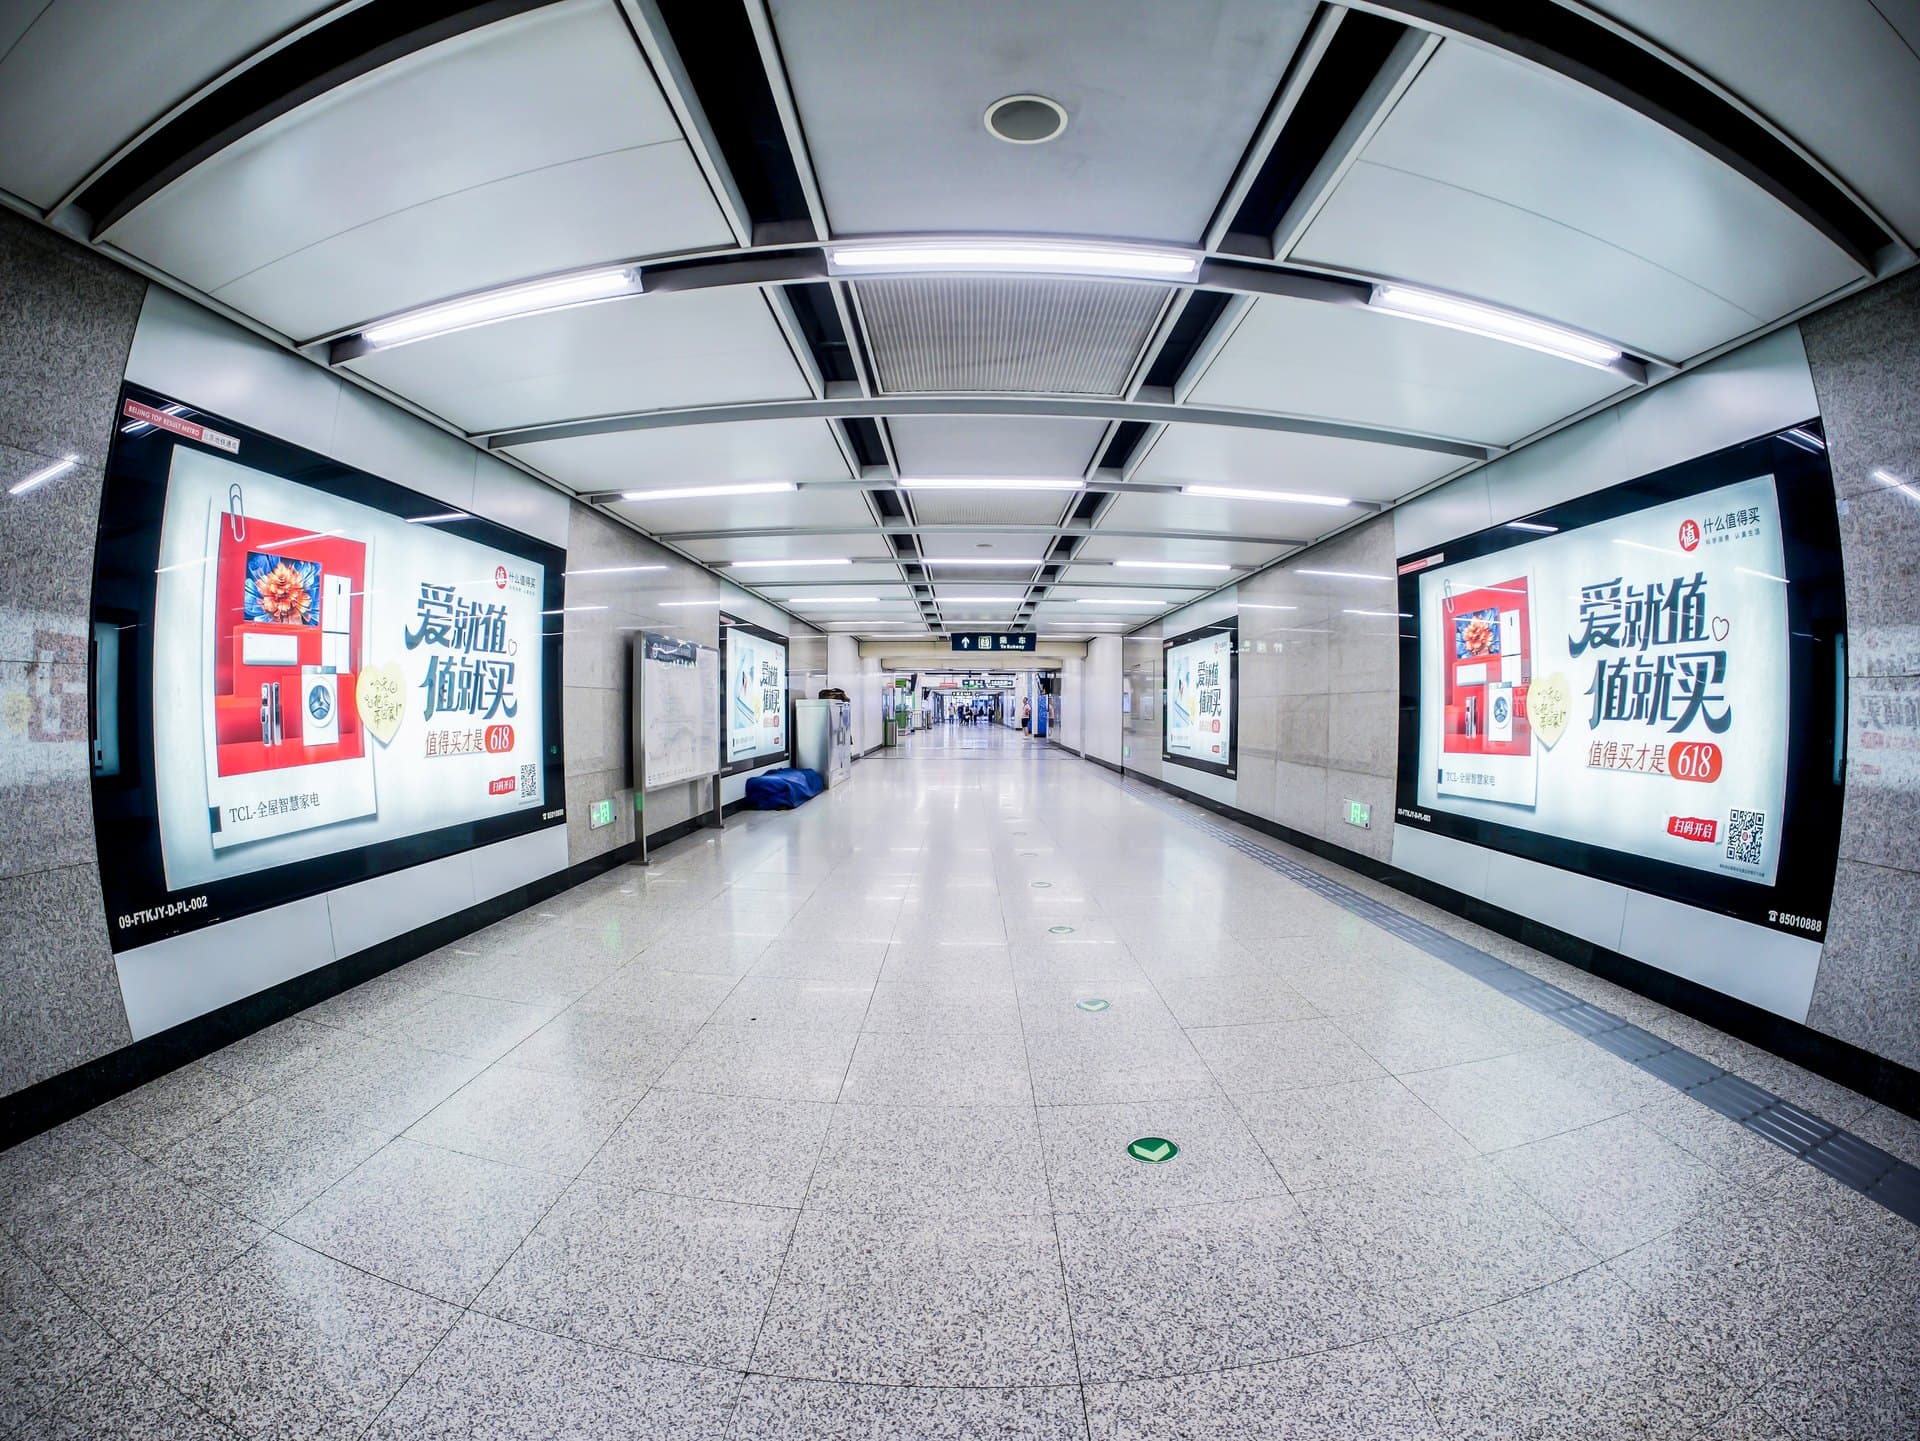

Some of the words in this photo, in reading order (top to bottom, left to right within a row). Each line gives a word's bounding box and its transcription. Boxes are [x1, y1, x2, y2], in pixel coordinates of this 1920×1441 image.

[128, 405, 151, 419] BEIJING
[151, 412, 162, 423] TOP
[1680, 521, 1699, 549] 值
[1703, 506, 1761, 534] 什么值得买
[508, 571, 536, 589] 什么值得买
[404, 581, 508, 655] 爱就值
[1568, 571, 1710, 659] 爱就值
[418, 655, 518, 722] 值就买
[1583, 650, 1733, 734] 值就买
[425, 729, 484, 757] 值得买才是
[490, 726, 511, 750] 618
[1588, 740, 1667, 773] 值得买才是
[1677, 743, 1713, 778] 618
[1674, 818, 1714, 839] 扫码开启
[118, 895, 209, 929] 09-FTKJY-D-PL-002
[1778, 912, 1823, 933] 85010888
